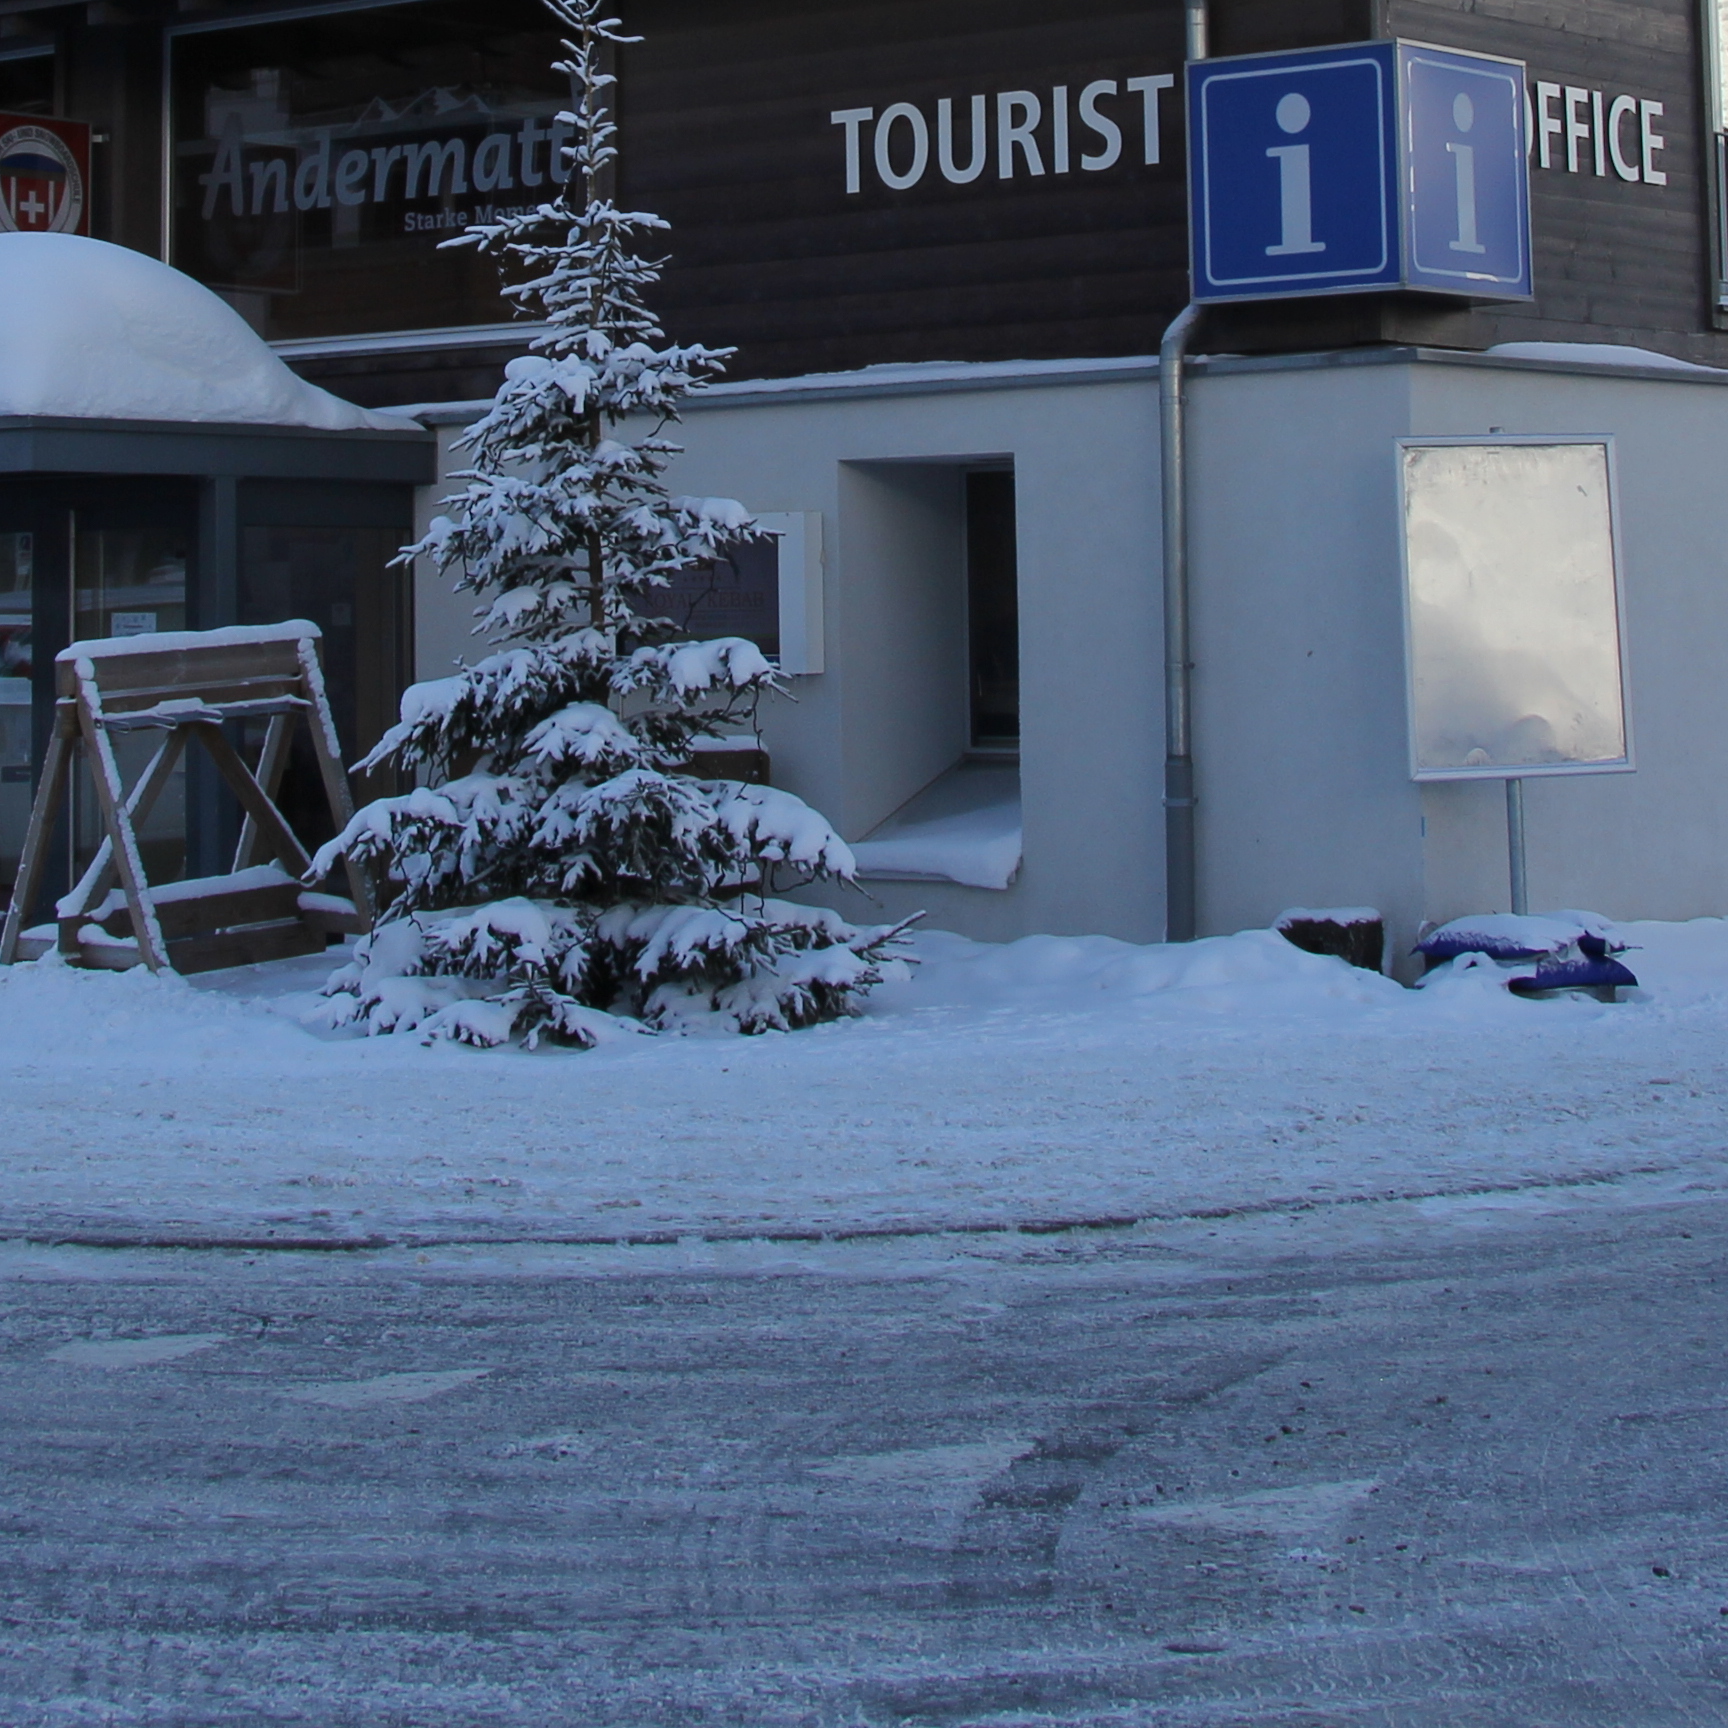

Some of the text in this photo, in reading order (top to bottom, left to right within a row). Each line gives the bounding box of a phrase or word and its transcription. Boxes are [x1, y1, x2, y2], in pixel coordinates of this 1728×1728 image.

[198, 111, 579, 221] Andermatt
[830, 74, 1175, 194] TOURIST
[1524, 83, 1667, 186] FFICE
[404, 207, 468, 232] Starke
[707, 591, 764, 609] KEBAB
